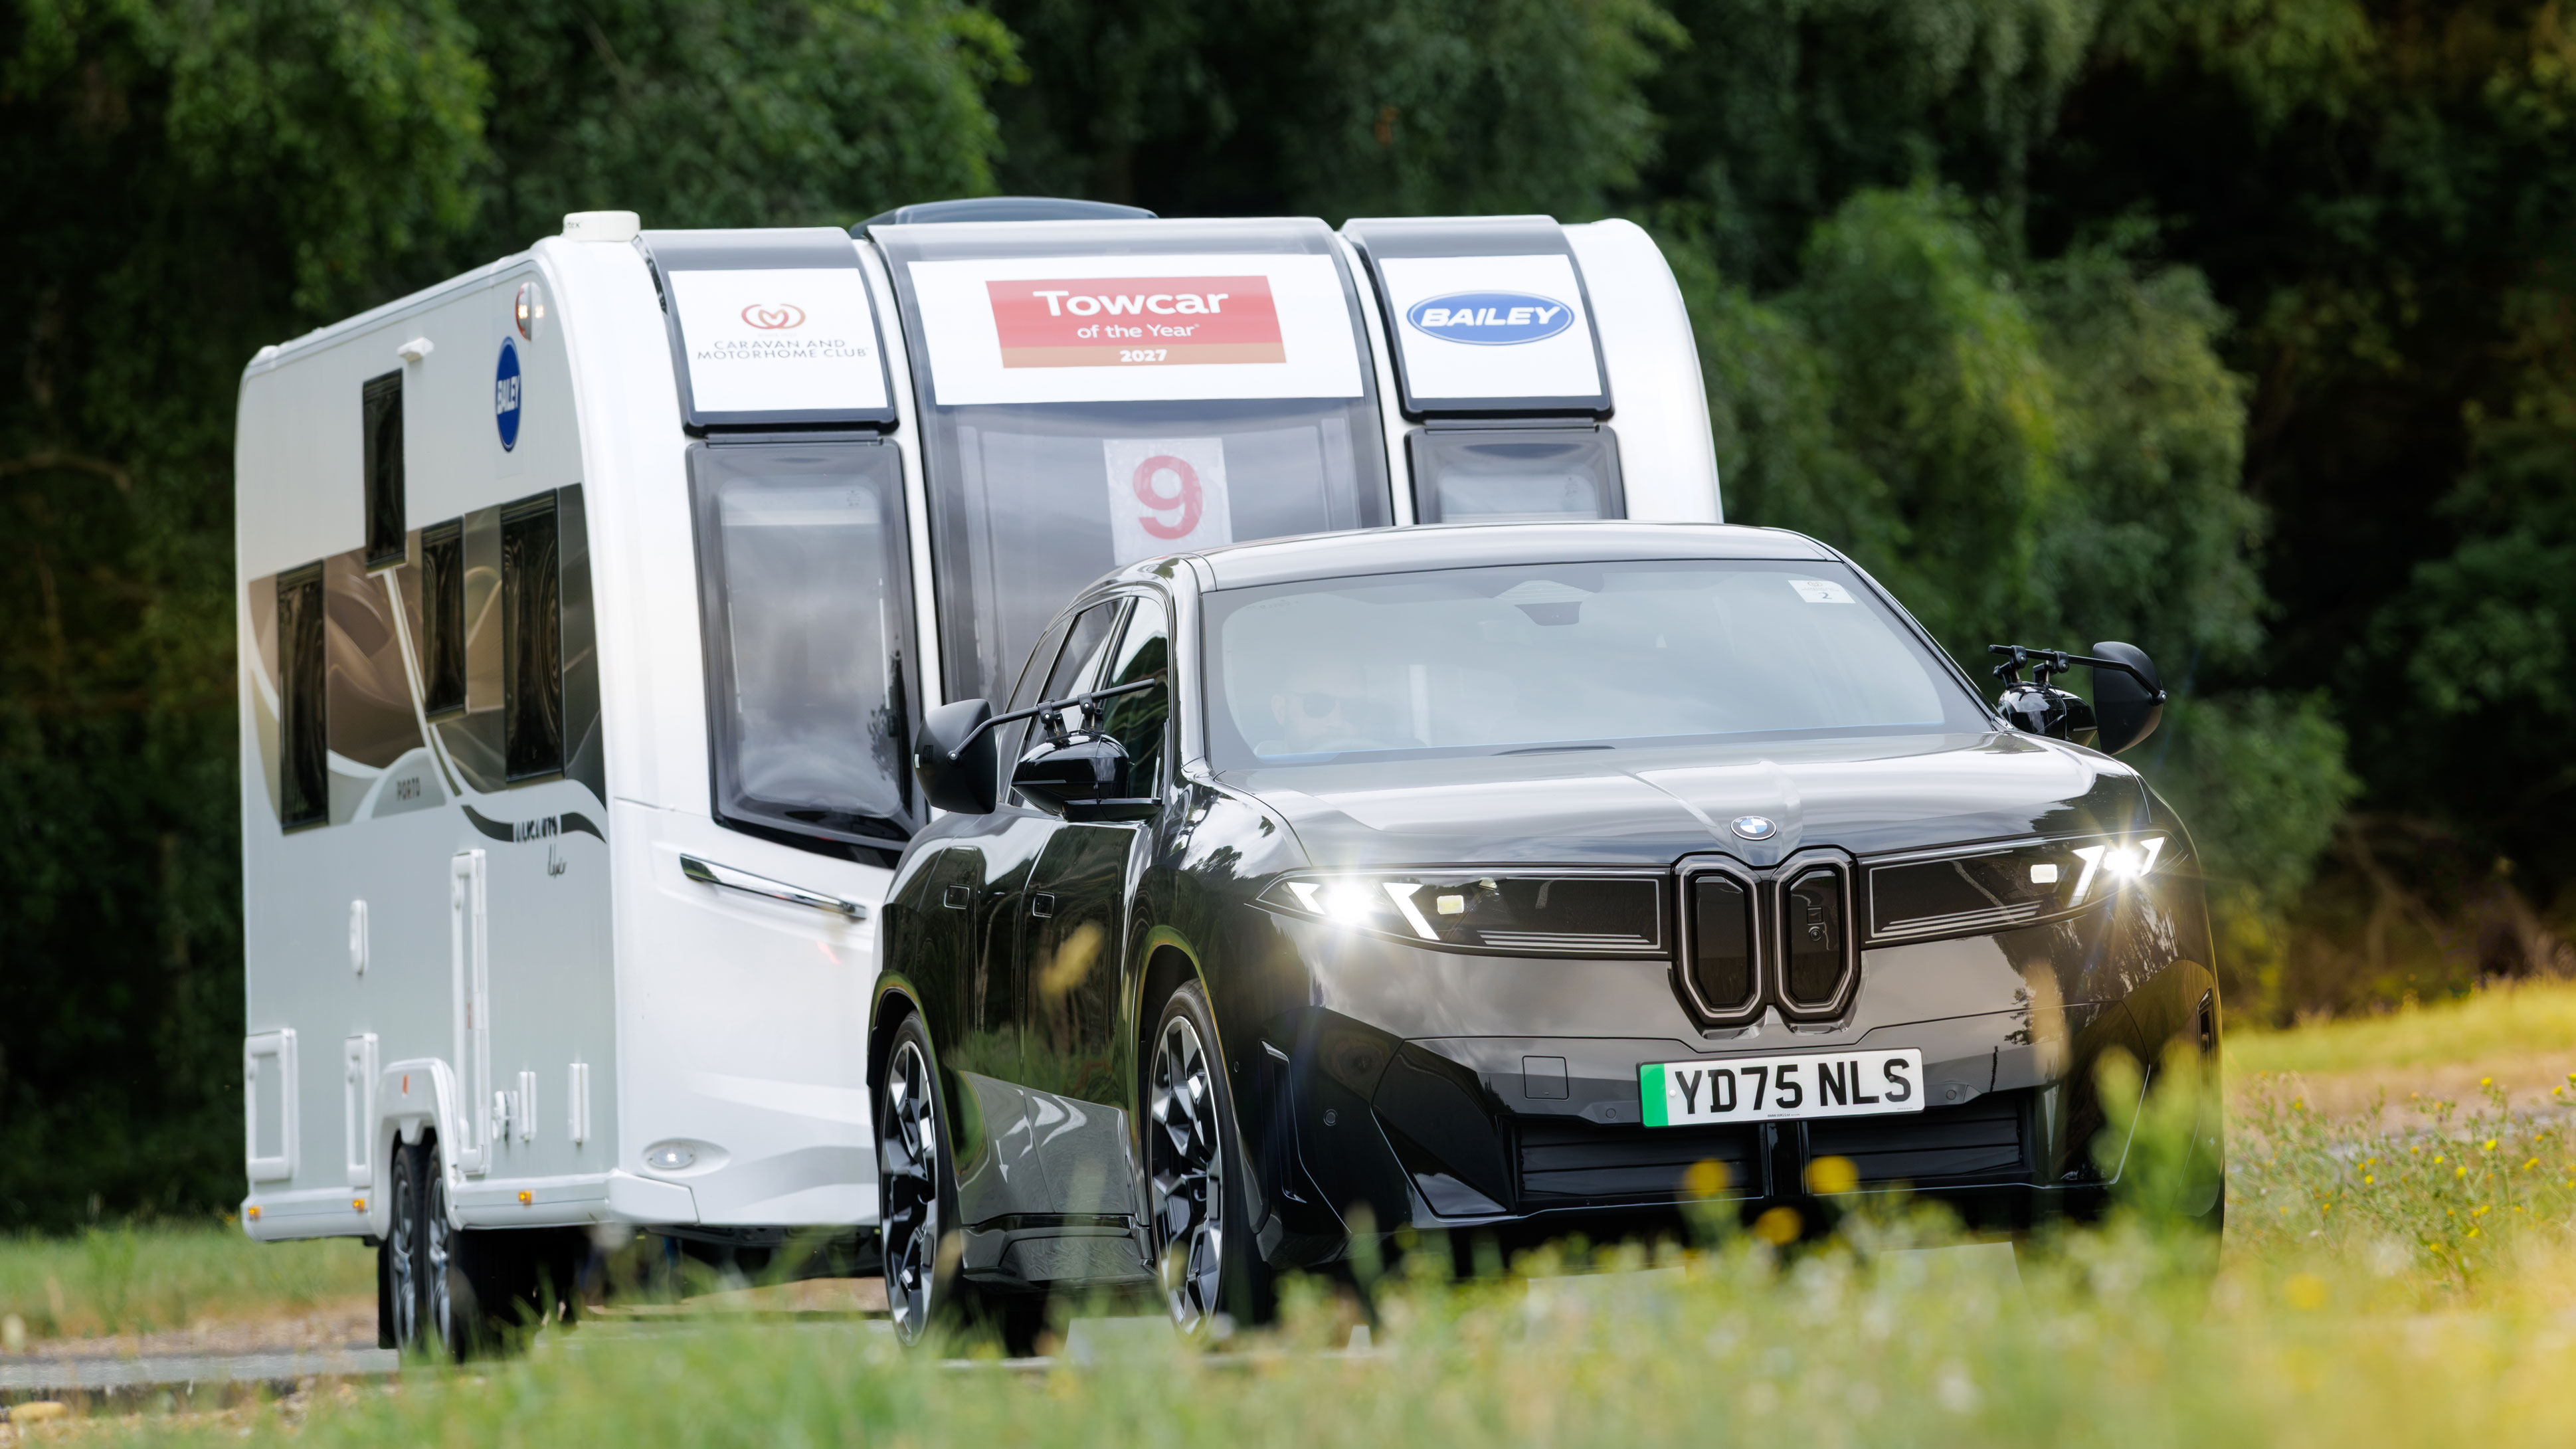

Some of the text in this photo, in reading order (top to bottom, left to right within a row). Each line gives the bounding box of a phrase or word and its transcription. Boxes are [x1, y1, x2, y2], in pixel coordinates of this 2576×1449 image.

[1033, 290, 1229, 316] Towcar
[1420, 306, 1561, 327] BAILEY
[1077, 324, 1195, 339] of the Year
[697, 348, 867, 360] MOTORHOME CLUB
[714, 339, 846, 350] CARAVAN AND
[1120, 349, 1168, 362] 2027
[497, 375, 521, 415] BAILEY
[1133, 455, 1204, 539] 9
[397, 777, 420, 801] PORTO
[1675, 1058, 1912, 1115] YD75 NLS
